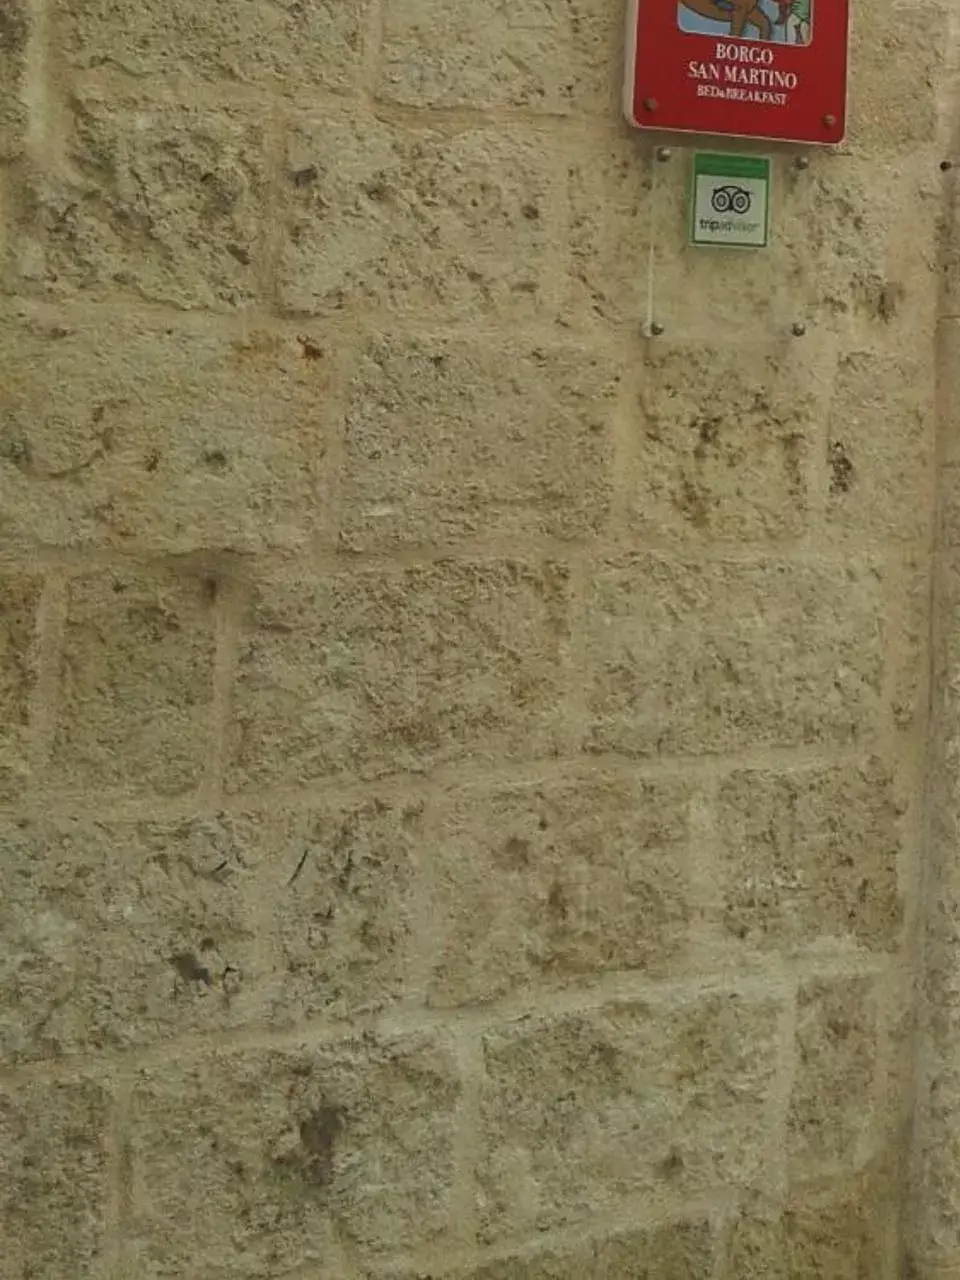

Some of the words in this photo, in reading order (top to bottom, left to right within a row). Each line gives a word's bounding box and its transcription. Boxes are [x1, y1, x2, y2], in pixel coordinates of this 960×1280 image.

[716, 43, 774, 64] BORGO
[688, 61, 719, 80] SAN
[724, 66, 797, 89] MARTINO
